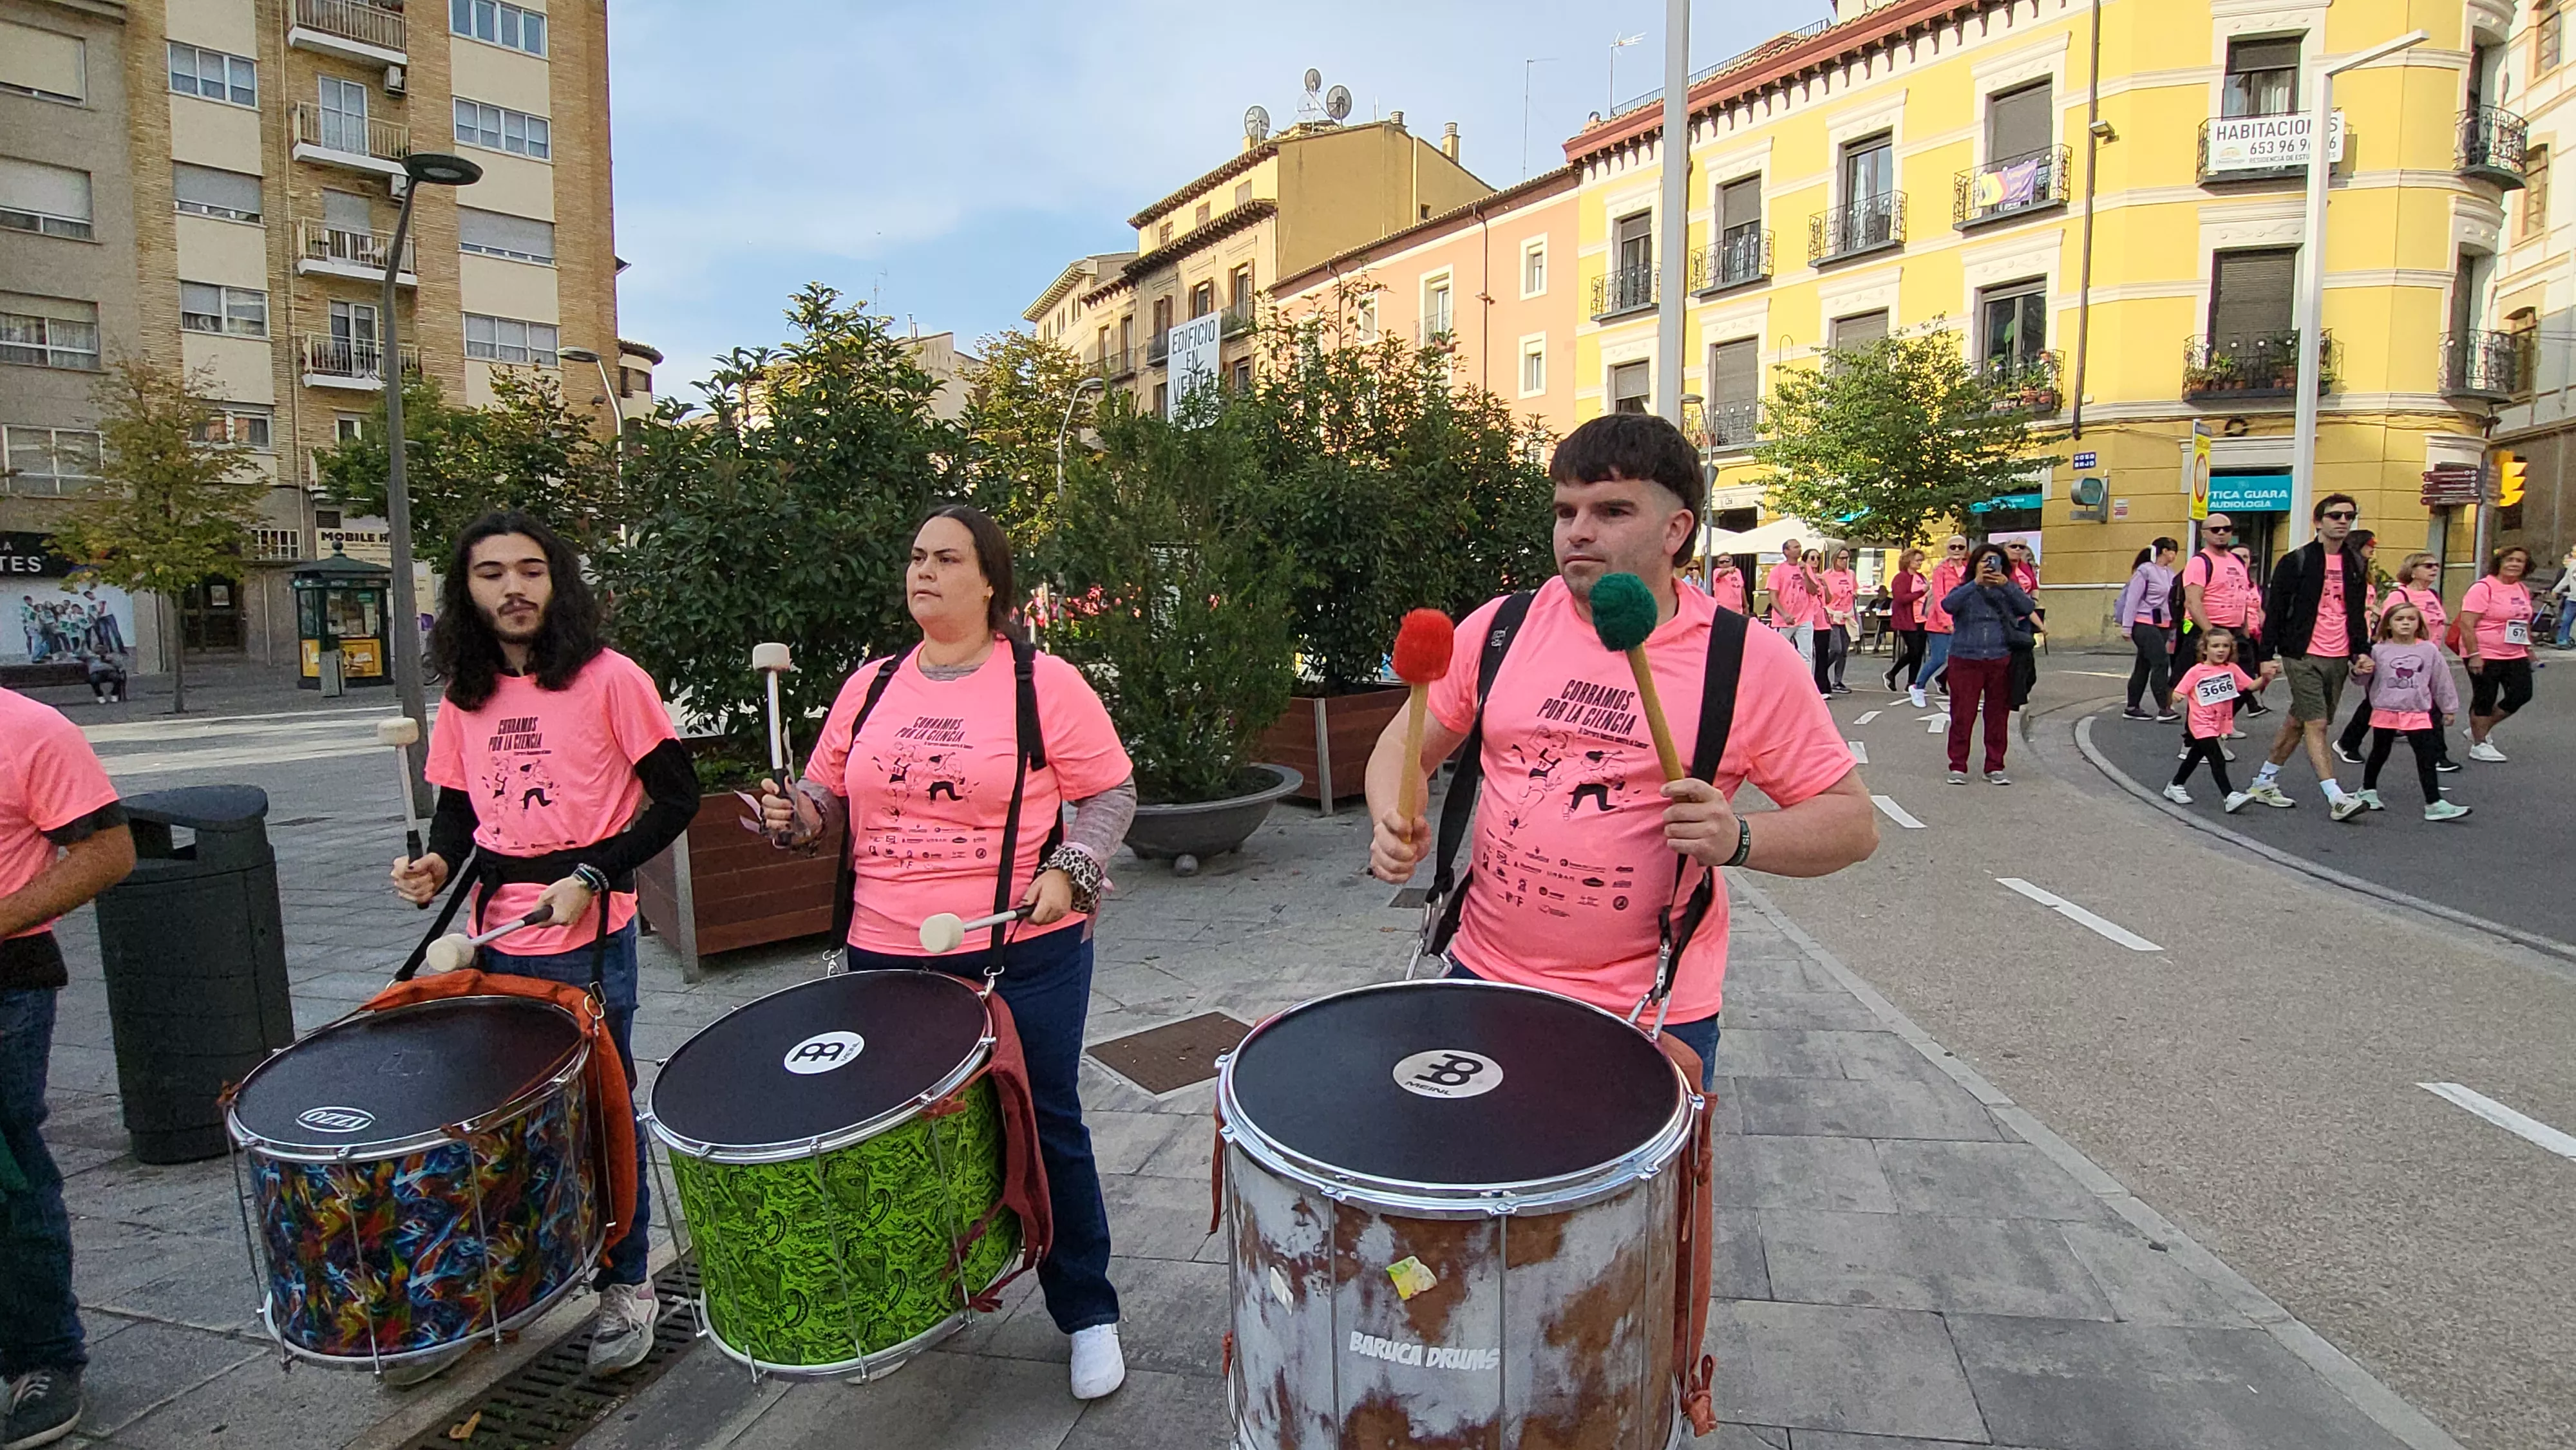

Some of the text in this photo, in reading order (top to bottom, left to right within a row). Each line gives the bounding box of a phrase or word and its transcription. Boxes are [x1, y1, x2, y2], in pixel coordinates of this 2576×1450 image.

[2217, 117, 2338, 141] HABITACIOS
[2249, 141, 2274, 155] 653
[2279, 139, 2295, 153] 96
[2295, 151, 2336, 161] ESTUES
[1172, 319, 1215, 355] EDIFICIO
[1186, 348, 1198, 370] EN
[2208, 490, 2288, 500] TICA GUARA
[321, 532, 375, 542] MOBILE
[2513, 628, 2525, 637] 67
[1560, 679, 1635, 711] CORRAMOS
[2201, 681, 2233, 697] 3666
[1537, 698, 1637, 735] POR LA CIENCIA
[894, 727, 917, 739] POR
[914, 729, 929, 740] LA
[504, 735, 513, 751] LA
[1405, 1081, 1452, 1095] MEINL
[1349, 1331, 1500, 1371] BARUCA DRUMS
